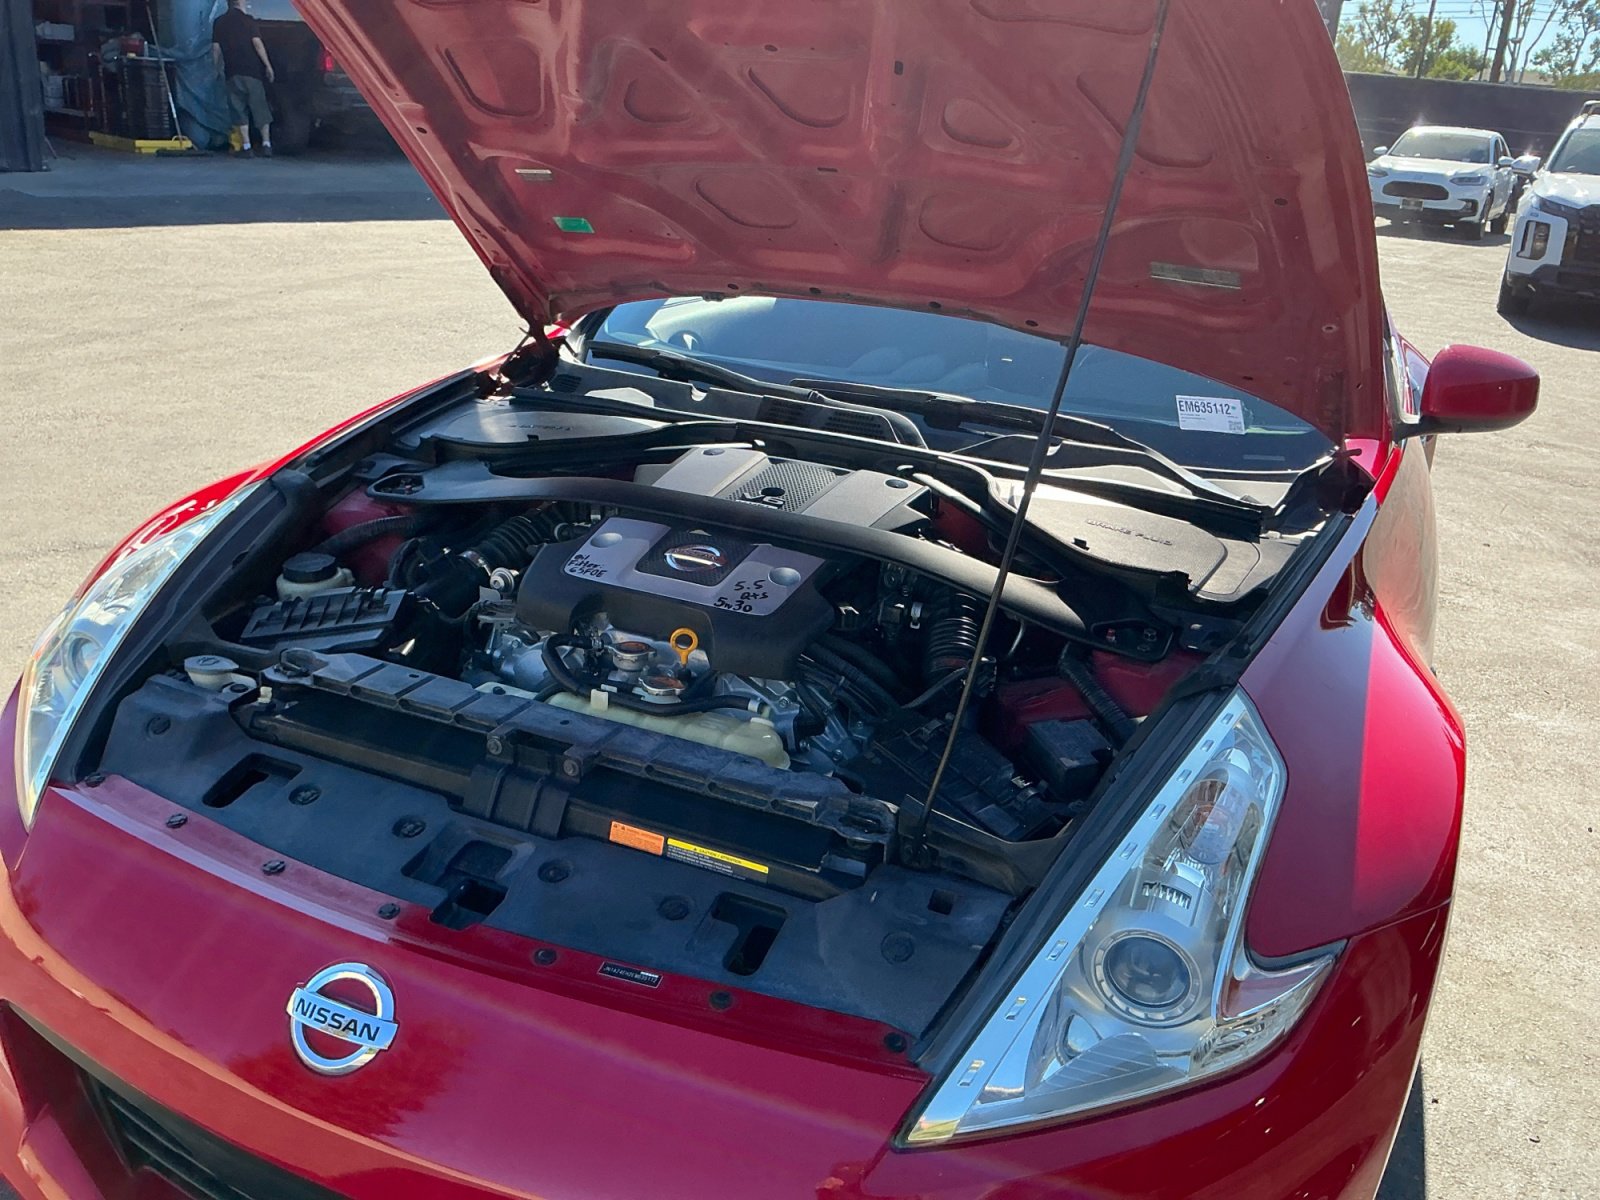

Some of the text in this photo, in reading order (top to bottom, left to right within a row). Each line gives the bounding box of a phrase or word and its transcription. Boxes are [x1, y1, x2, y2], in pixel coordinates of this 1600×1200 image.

[1178, 400, 1231, 415] EM635112
[734, 579, 766, 591] 5.5
[295, 997, 381, 1042] NISSAN
